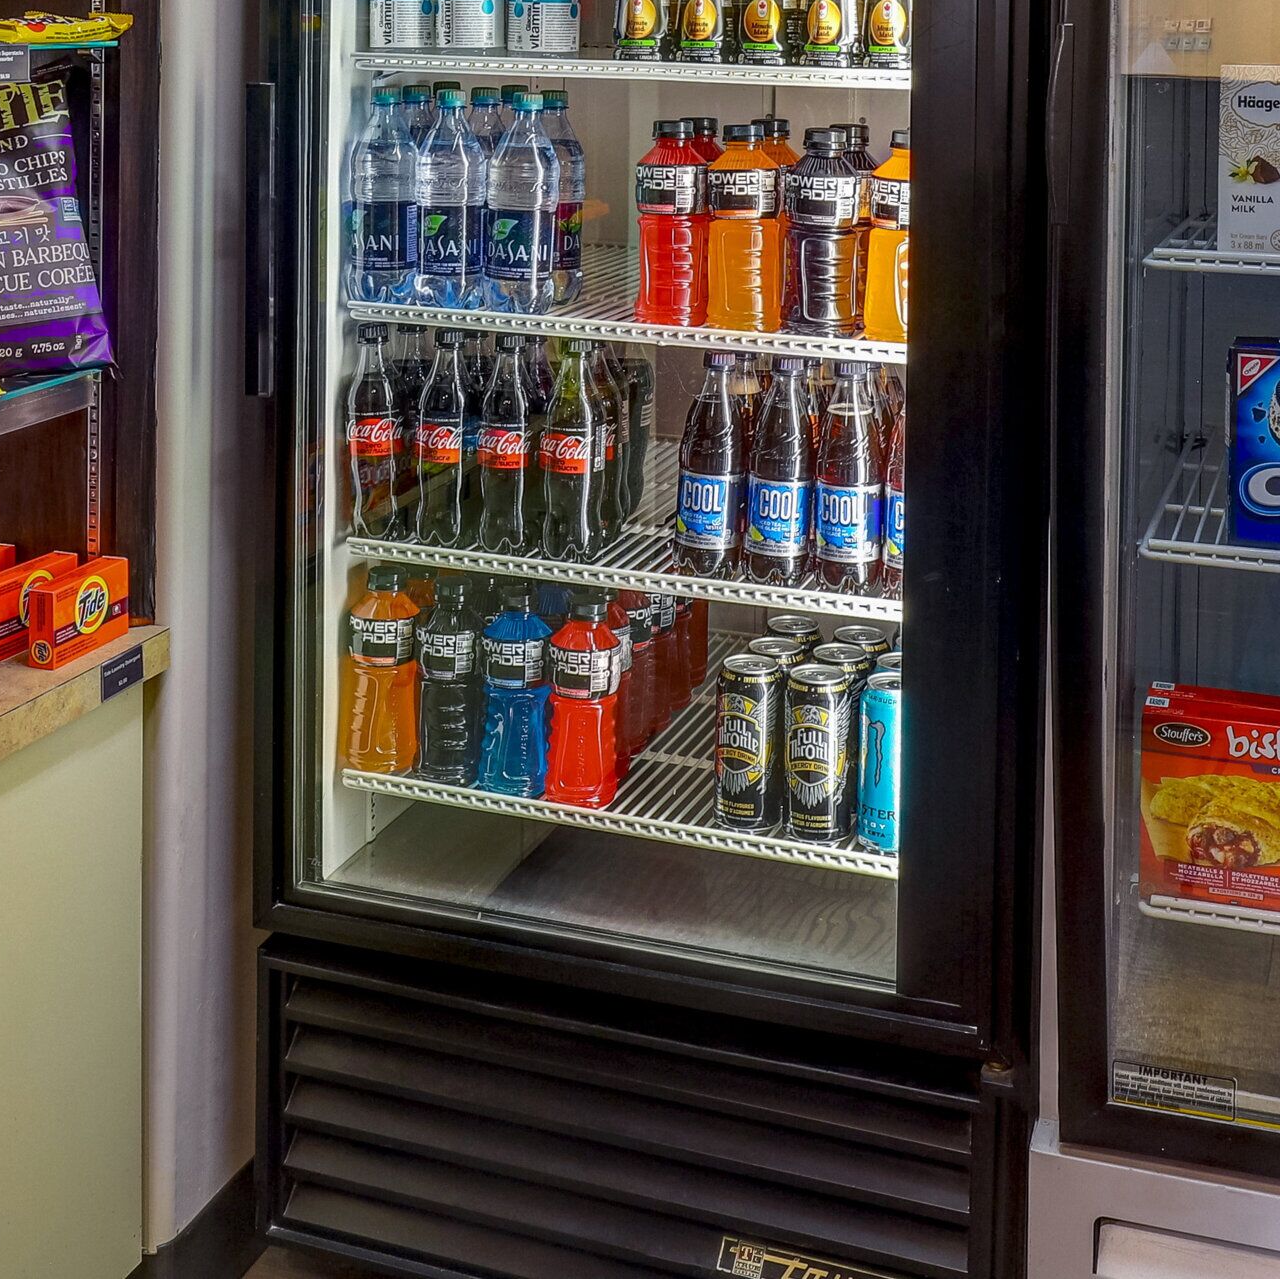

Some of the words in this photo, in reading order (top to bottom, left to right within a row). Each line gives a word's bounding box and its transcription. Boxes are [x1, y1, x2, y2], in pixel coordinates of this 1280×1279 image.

[14, 149, 66, 173] CHIPS
[707, 171, 757, 186] POWER
[1231, 194, 1274, 204] VANILLA
[1231, 205, 1255, 213] MILK
[487, 239, 548, 263] DASANI
[31, 343, 50, 355] 7.75
[683, 481, 723, 512] COOL
[759, 484, 800, 517] COOL
[821, 488, 862, 522] COOL
[76, 587, 106, 630] Tide
[1160, 724, 1205, 745] Stouffer's
[1178, 869, 1224, 880] MOZZARELLA
[1231, 872, 1269, 881] BOULETTES
[1137, 1065, 1209, 1088] IMPORTANT
